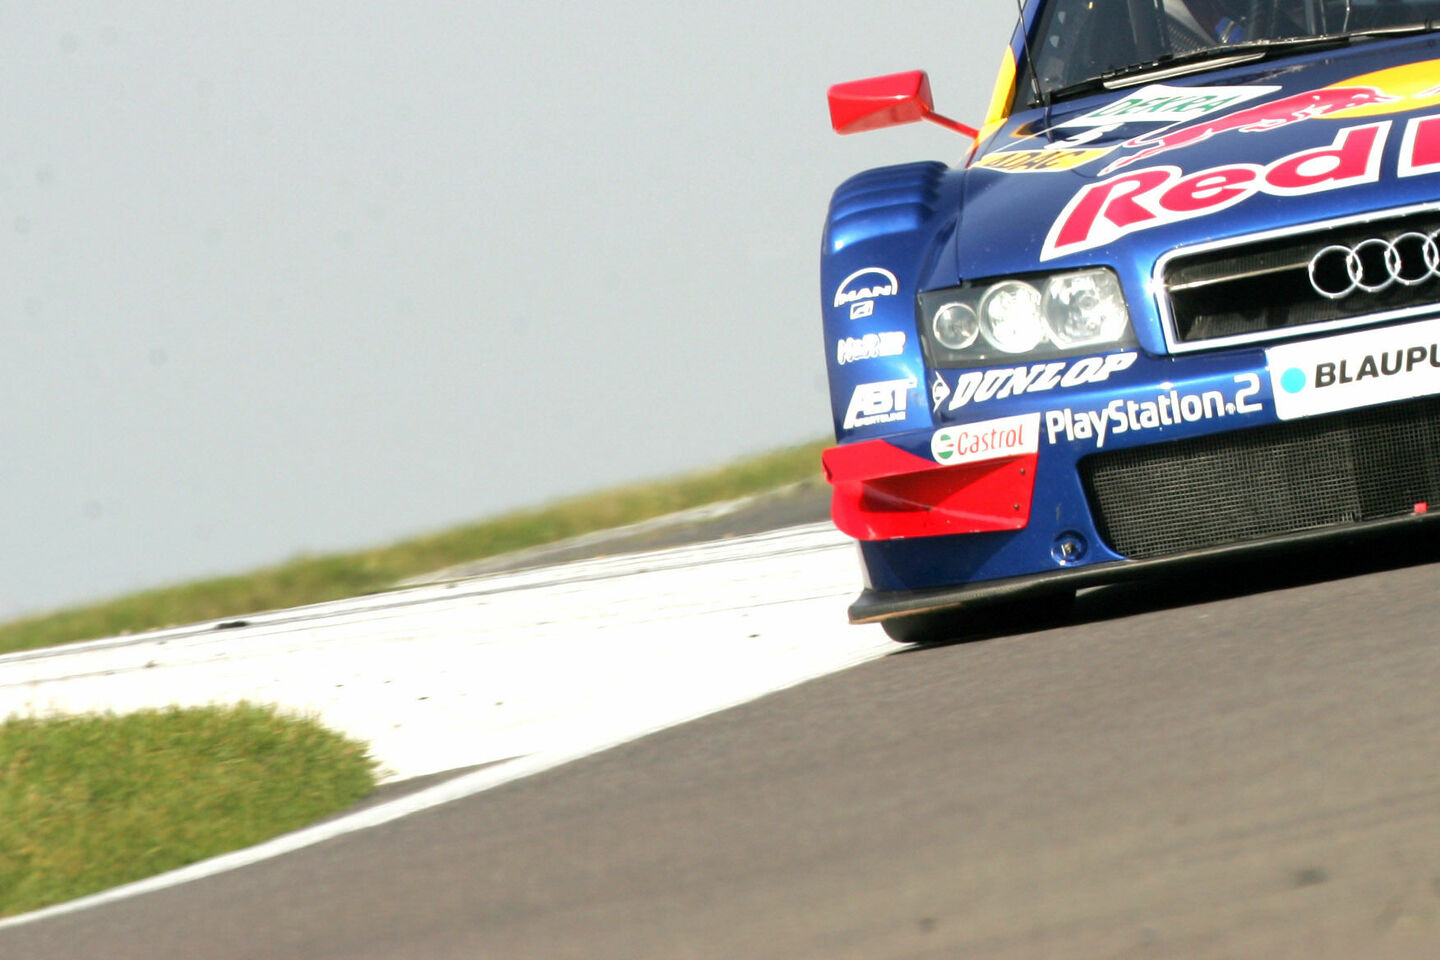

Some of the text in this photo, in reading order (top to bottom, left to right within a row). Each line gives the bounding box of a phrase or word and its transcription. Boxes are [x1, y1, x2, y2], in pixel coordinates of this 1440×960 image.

[1095, 93, 1241, 119] DEKRA
[989, 150, 1082, 170] ADAC
[1040, 120, 1392, 262] Red
[948, 352, 1138, 411] DUNLOP
[843, 378, 917, 430] ABT
[957, 423, 1024, 456] Castrol
